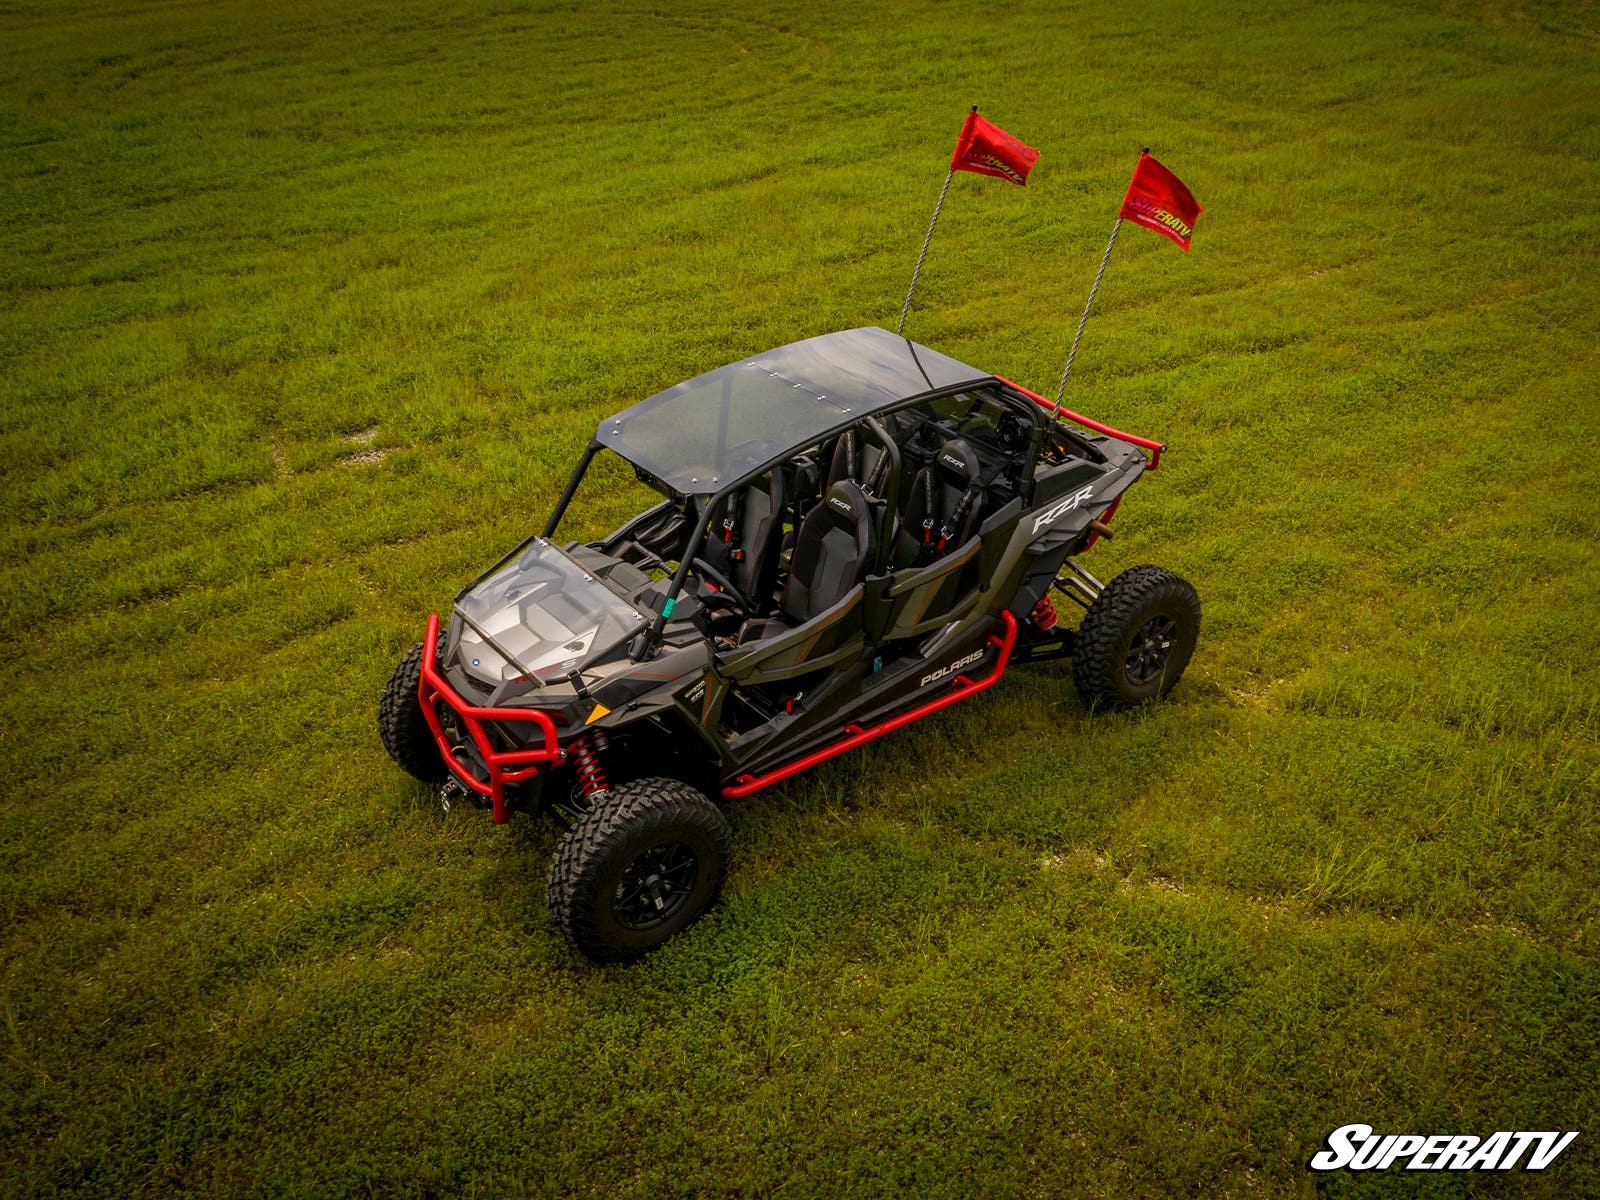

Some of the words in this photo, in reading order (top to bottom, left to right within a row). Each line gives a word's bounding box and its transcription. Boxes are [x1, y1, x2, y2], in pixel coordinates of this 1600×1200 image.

[943, 454, 965, 469] RZR
[830, 497, 852, 511] RZR
[1032, 485, 1093, 535] RZR
[920, 648, 984, 687] POLARIS
